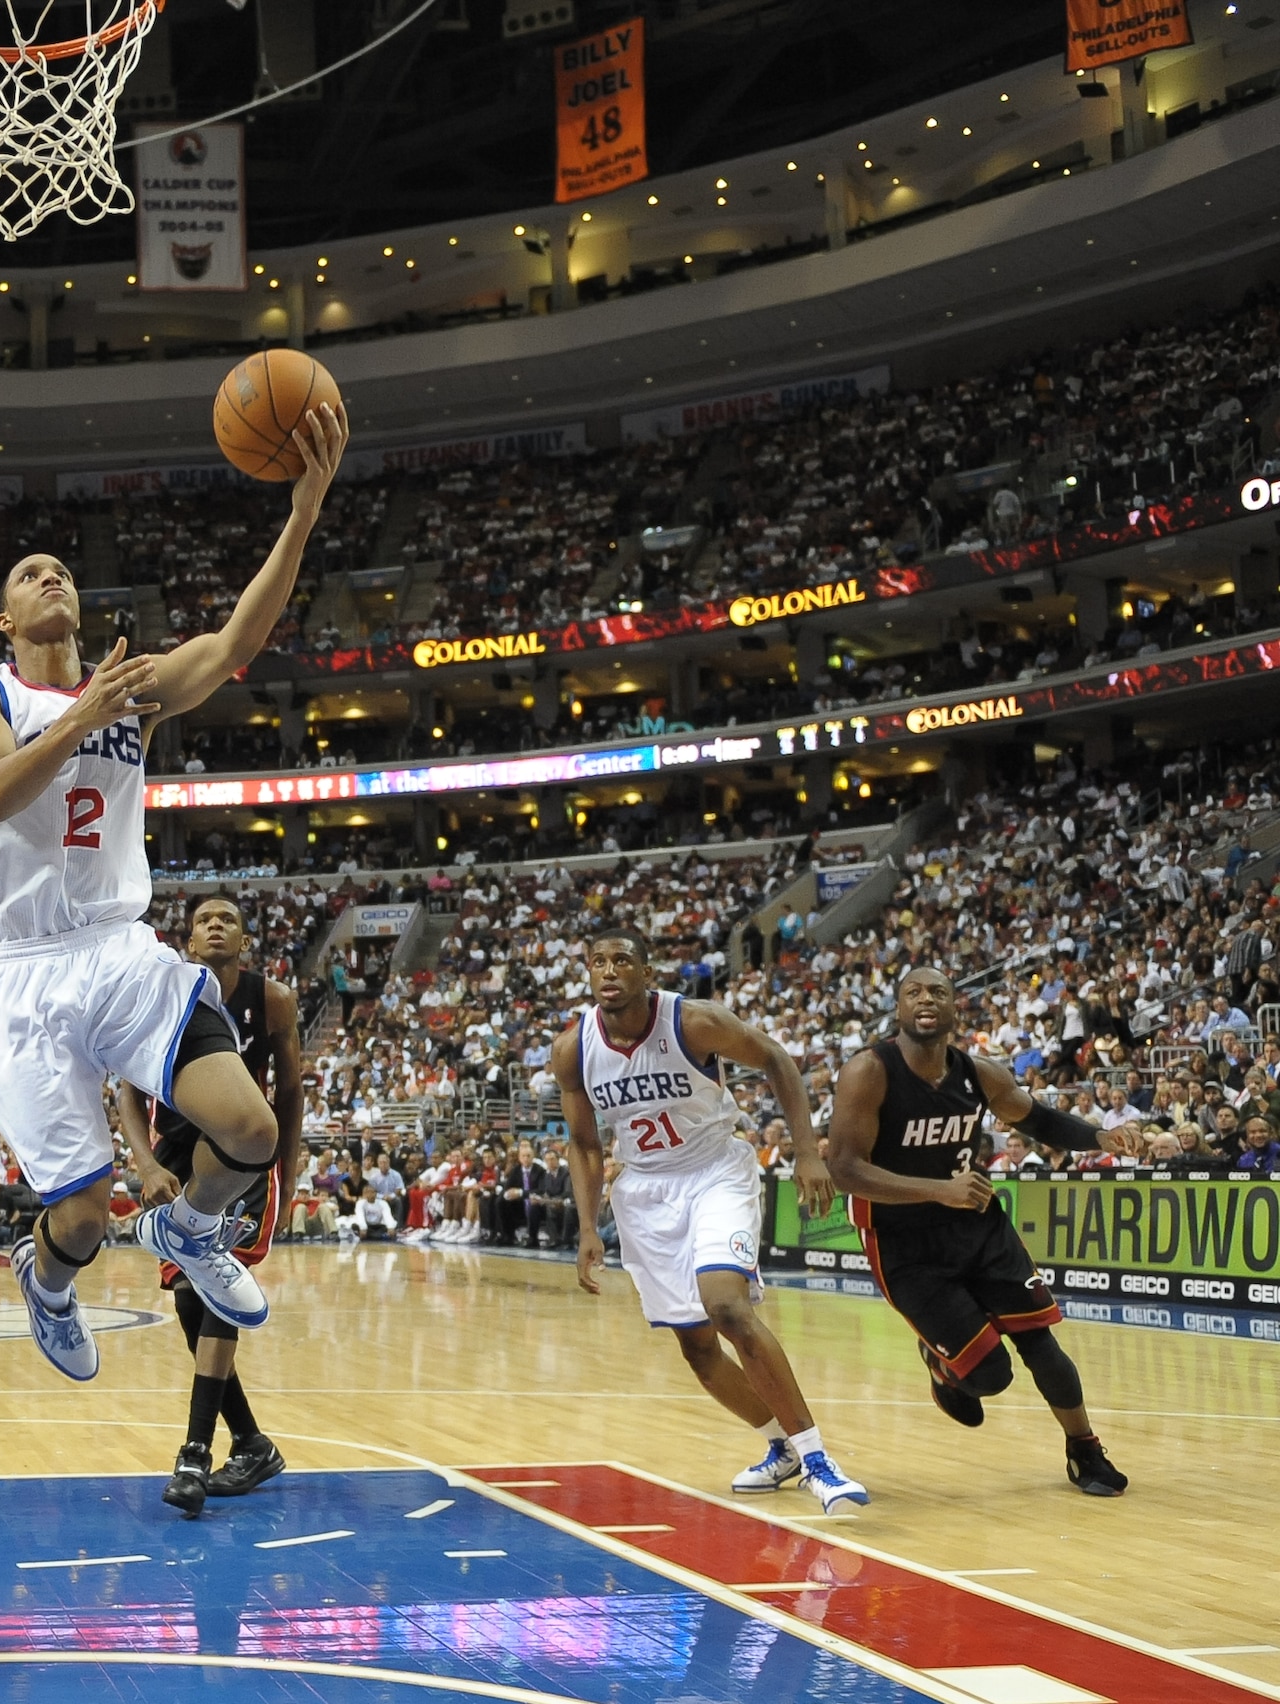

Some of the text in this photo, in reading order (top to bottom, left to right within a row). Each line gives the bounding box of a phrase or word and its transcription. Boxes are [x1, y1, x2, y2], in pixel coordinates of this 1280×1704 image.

[1073, 6, 1181, 41] PHILADELPHIA
[563, 29, 632, 70] BILLY
[1086, 24, 1170, 57] SELL-OUTS
[568, 69, 632, 107] JOEL
[581, 106, 622, 151] 48
[143, 179, 237, 190] CALDER CUP
[729, 580, 865, 626] COLONIAL
[413, 632, 545, 668] COLONIAL
[906, 696, 1023, 734] COLONIAL
[369, 772, 390, 794] at
[396, 769, 430, 792] the
[568, 752, 642, 776] Center
[362, 909, 408, 920] GEICO
[394, 922, 407, 933] 10
[592, 1072, 693, 1111] SIXERS
[630, 1111, 684, 1152] 21
[901, 1102, 982, 1147] HEAT
[951, 1147, 973, 1177] 3
[1188, 1171, 1210, 1181] GEICO
[1228, 1171, 1251, 1181] GEICO
[805, 1251, 836, 1267] GEICO
[1064, 1270, 1110, 1290] GEICO
[1120, 1274, 1170, 1295] GEICO
[1181, 1279, 1235, 1300] GEICO
[1066, 1301, 1112, 1321] GEICO
[1122, 1306, 1171, 1327] GEICO
[1183, 1312, 1236, 1334] GEICO
